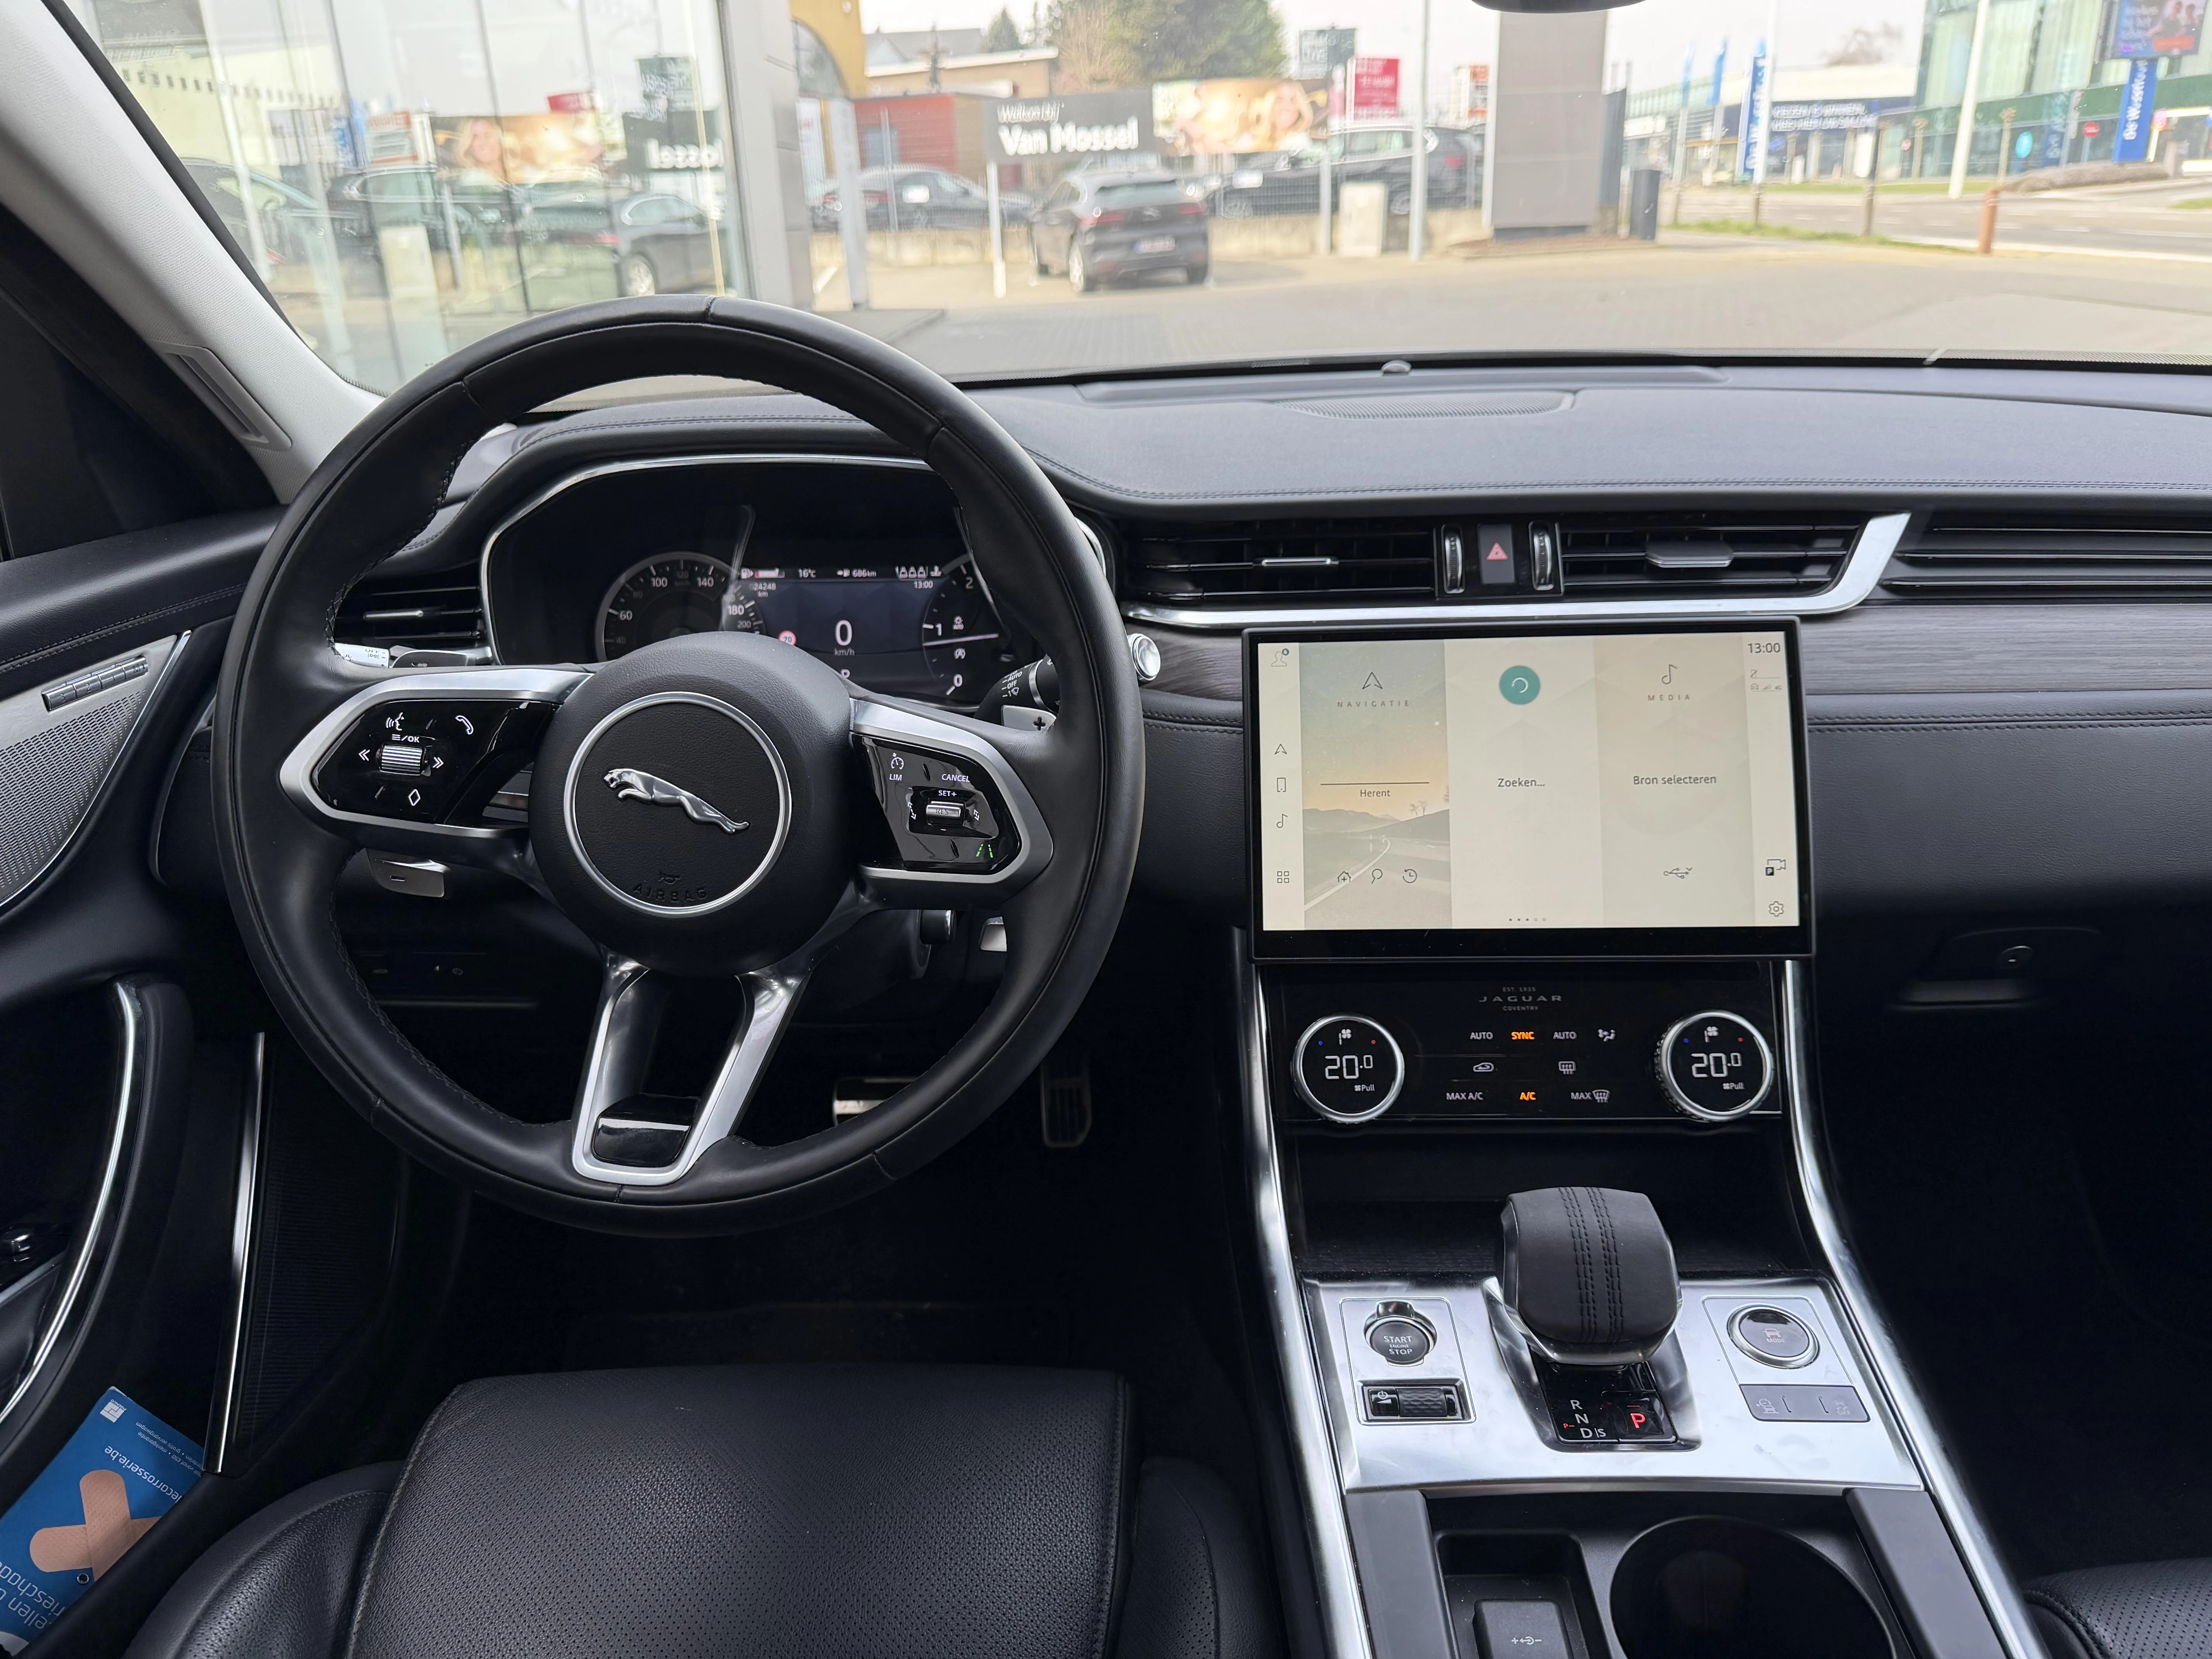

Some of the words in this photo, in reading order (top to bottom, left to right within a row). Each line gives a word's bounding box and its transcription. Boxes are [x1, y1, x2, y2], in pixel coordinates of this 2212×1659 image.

[998, 124, 1048, 155] Van
[1050, 115, 1139, 153] Mossel
[651, 577, 668, 587] 100
[697, 577, 714, 587] 140
[914, 580, 933, 589] 13:00
[965, 576, 974, 589] 2
[619, 610, 633, 621] 60
[728, 604, 745, 616] 180
[738, 620, 752, 629] 200
[835, 620, 852, 646] 0
[935, 622, 942, 636] 1
[834, 648, 855, 656] km/h
[1747, 642, 1781, 653] 13:00
[953, 673, 963, 687] 0
[1007, 671, 1022, 682] AUTO
[86, 683, 92, 692] 2
[1007, 680, 1017, 689] OFF
[1337, 700, 1409, 708] NAVIGATIE
[941, 773, 970, 783] CANCEL
[1497, 777, 1546, 788] Zoeken...
[1633, 776, 1658, 785] Bron
[1661, 774, 1717, 785] selecteren
[1360, 789, 1391, 797] Herent
[632, 883, 708, 903] AIRBAG
[1470, 1031, 1494, 1040] AUTO
[1511, 1031, 1535, 1040] SYNC
[1553, 1031, 1577, 1040] AUTO
[1324, 1054, 1374, 1080] 20.0
[1691, 1052, 1742, 1078] 20.0
[1729, 1082, 1745, 1090] Pull
[1446, 1092, 1467, 1100] MAX
[1468, 1092, 1484, 1101] A/C
[1519, 1091, 1537, 1101] A/C
[1570, 1092, 1593, 1100] MAX
[1570, 1400, 1583, 1410] R
[1575, 1413, 1589, 1424] N
[1630, 1413, 1646, 1429] P
[136, 1421, 168, 1445] vervangwagen
[137, 1431, 167, 1453] merkgarantie
[167, 1443, 181, 1453] gratis
[180, 1461, 194, 1471] vanaf
[8, 1597, 52, 1629] ellen
